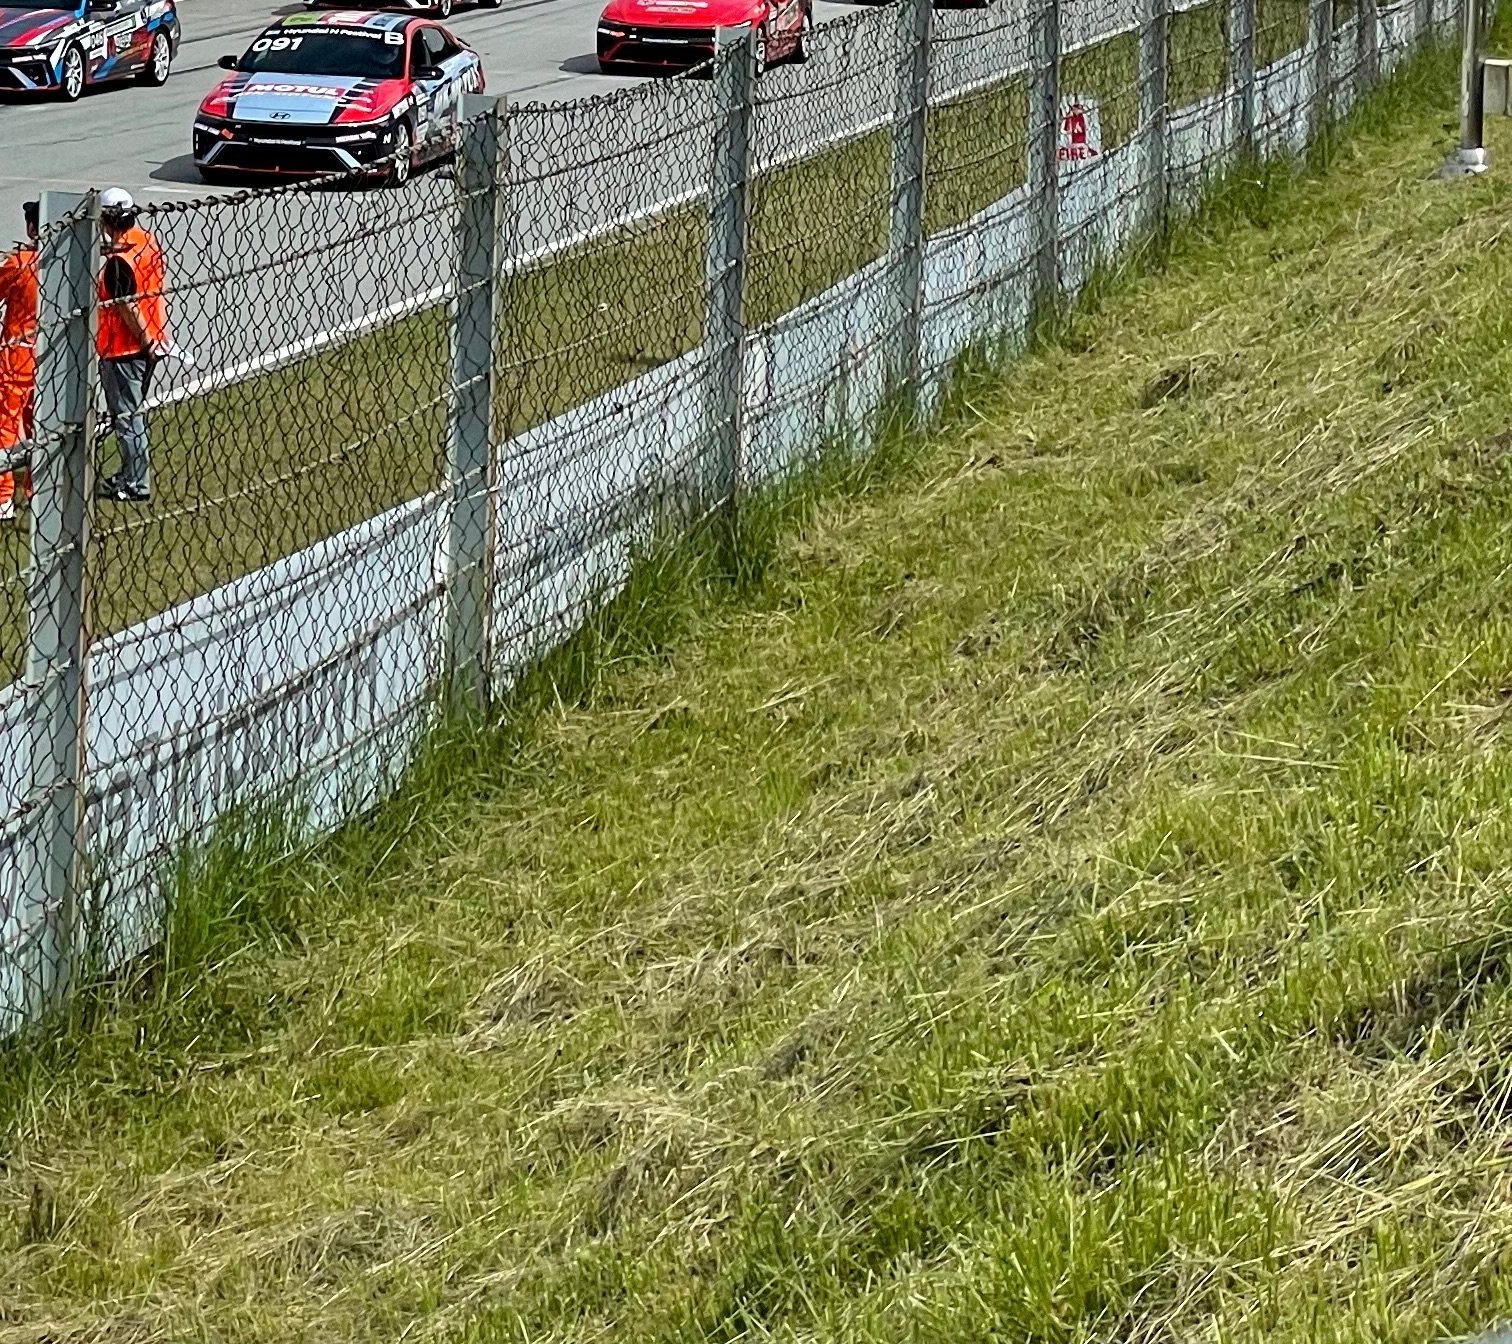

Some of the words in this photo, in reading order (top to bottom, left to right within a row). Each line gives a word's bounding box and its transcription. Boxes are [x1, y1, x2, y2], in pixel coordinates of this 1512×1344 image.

[283, 27, 330, 35] Hyundai
[340, 28, 383, 40] Festival
[384, 31, 405, 46] B
[252, 37, 304, 53] 091
[249, 84, 342, 97] MOTUL
